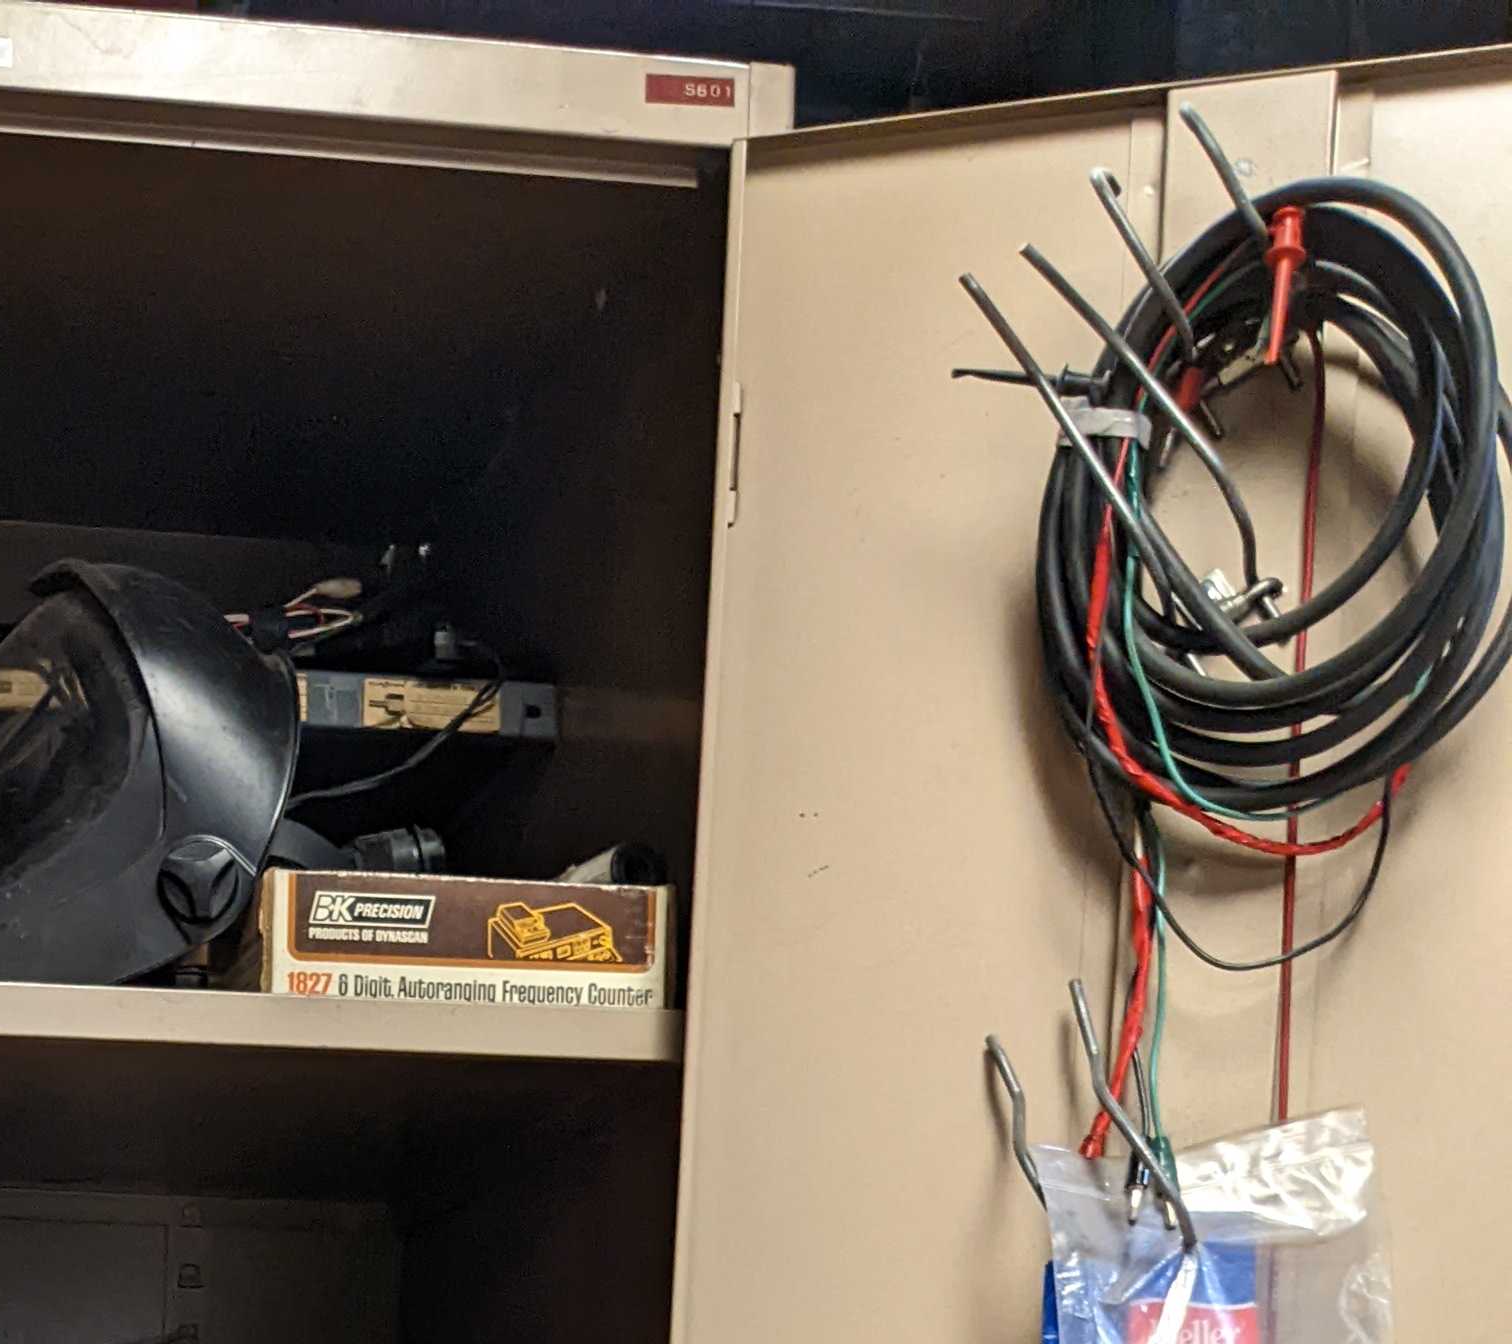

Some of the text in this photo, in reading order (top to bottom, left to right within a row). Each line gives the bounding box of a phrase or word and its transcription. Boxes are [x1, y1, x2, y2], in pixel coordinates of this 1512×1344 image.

[353, 902, 424, 920] PRECISION
[308, 927, 428, 943] PRODUCTS OF DYNASCAN
[288, 972, 332, 995] 1827
[338, 973, 349, 997] 6
[397, 976, 496, 1002] Autoranging
[502, 980, 583, 1006] Frequency
[588, 982, 652, 1006] Counter
